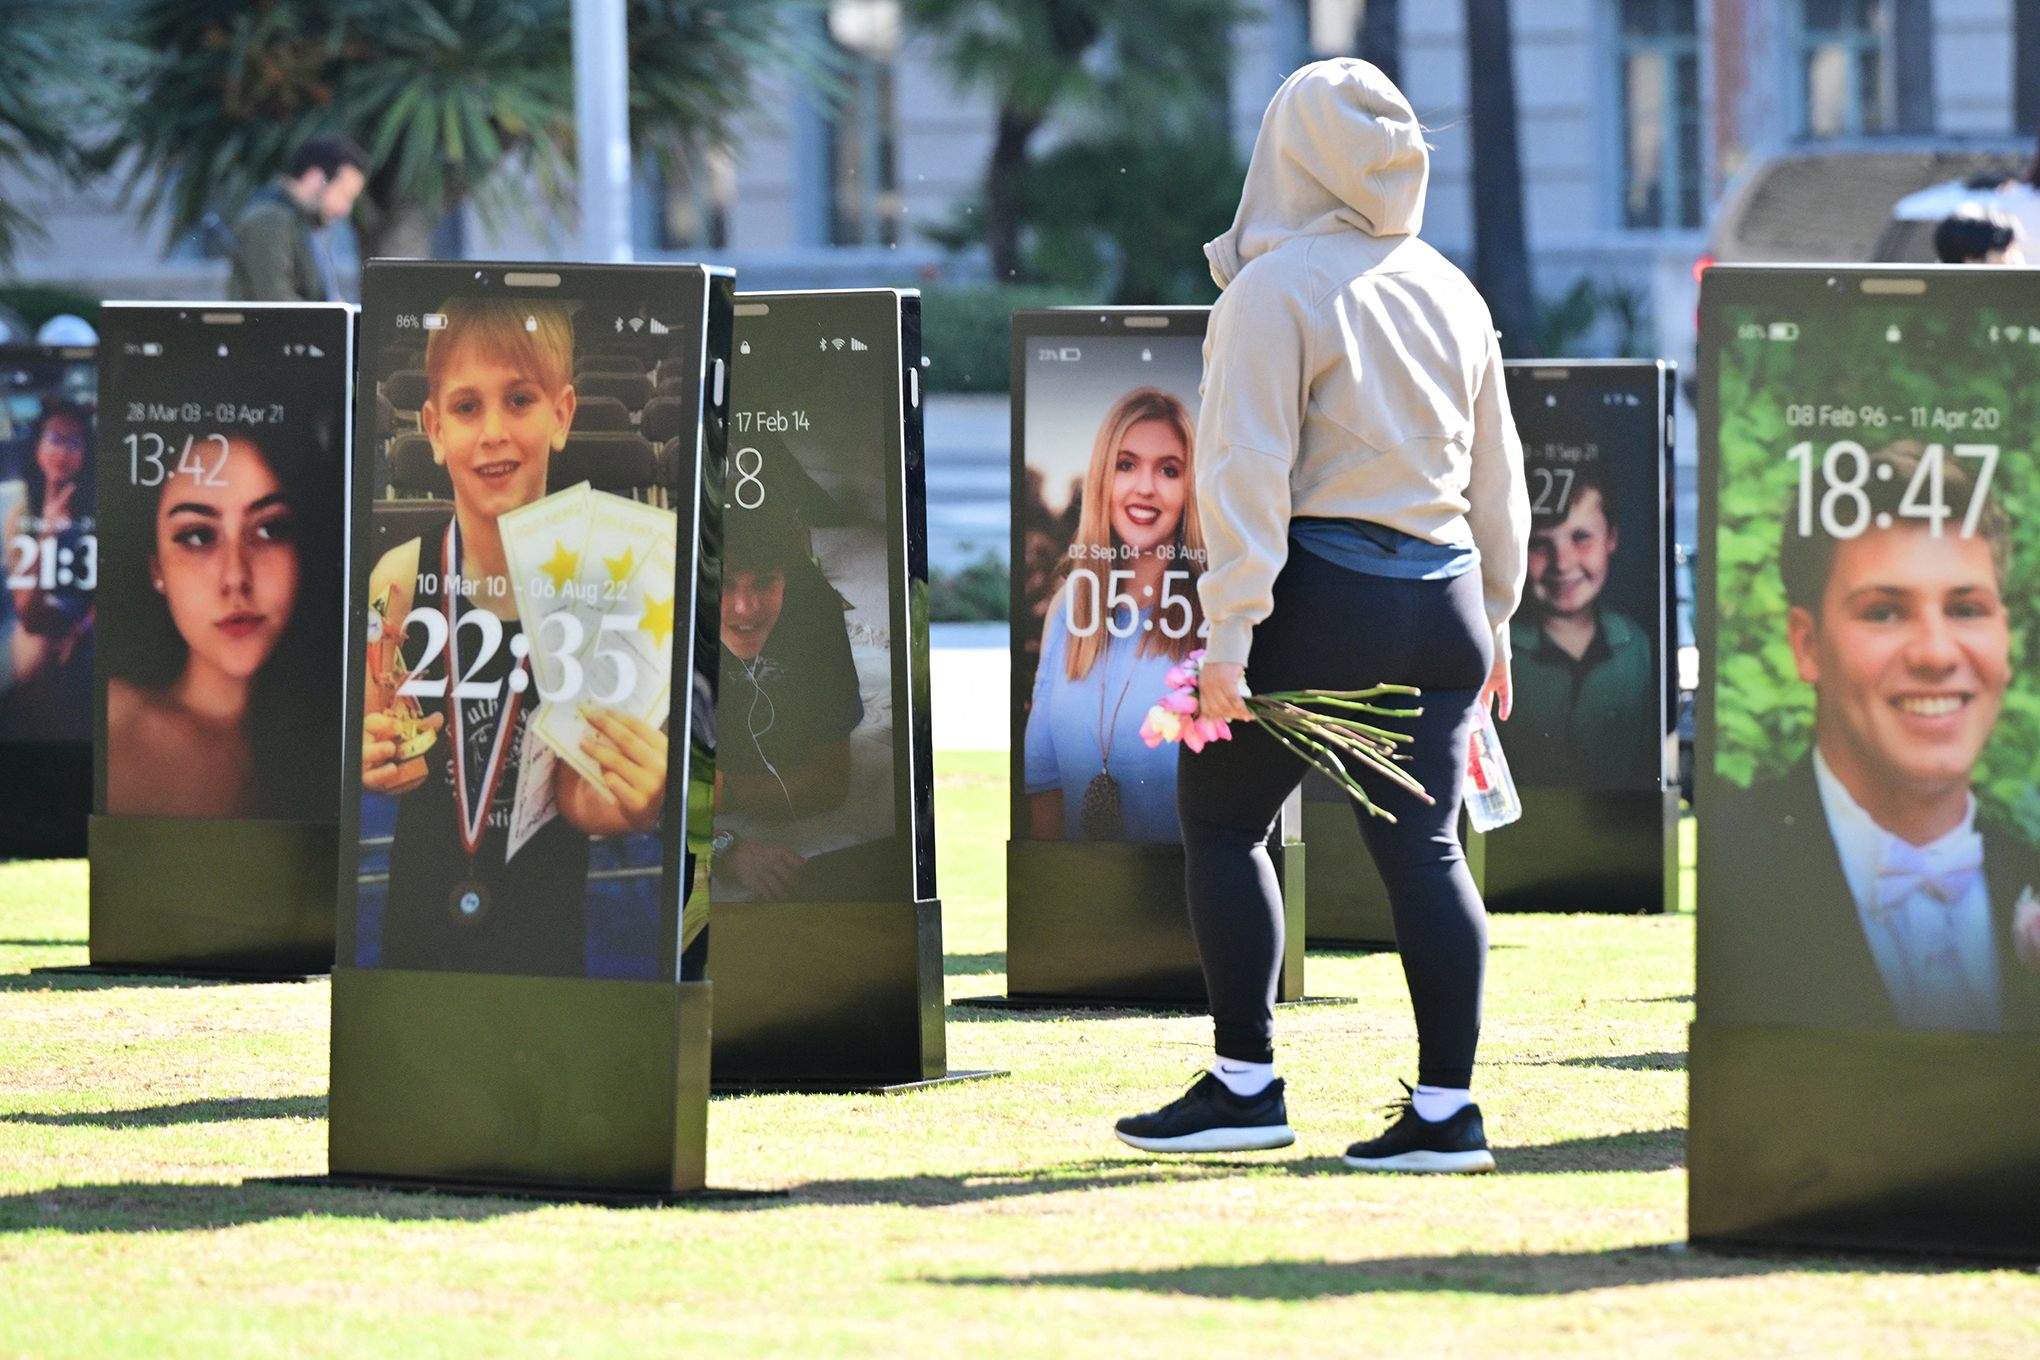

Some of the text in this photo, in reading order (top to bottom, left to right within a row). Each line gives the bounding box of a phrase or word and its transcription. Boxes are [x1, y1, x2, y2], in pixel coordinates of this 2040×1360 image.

[396, 313, 420, 329] 86%
[147, 402, 178, 423] Mar
[237, 403, 266, 427] Apr
[268, 404, 285, 424] 21
[735, 409, 811, 433] 17 Feb 14
[1786, 403, 1816, 427] 08
[1818, 403, 1857, 428] Feb
[1858, 404, 1888, 428] 96
[1909, 405, 1928, 428] 11
[1931, 406, 1967, 433] Apr
[1970, 406, 2000, 430] 20
[123, 431, 231, 487] 13:42
[724, 447, 766, 510] 8
[1531, 467, 1576, 515] 27
[1786, 440, 2001, 540] 18:47
[1068, 544, 1088, 560] 02
[1089, 545, 1118, 563] Sep
[1120, 545, 1140, 560] 04
[1156, 544, 1176, 560] 08
[1179, 545, 1207, 563] Aug
[416, 573, 438, 595] 10
[443, 575, 481, 596] Mar
[485, 576, 507, 597] 10
[529, 577, 556, 598] 06
[561, 579, 598, 605] Aug
[603, 581, 628, 601] 22
[396, 606, 643, 704] 22:35
